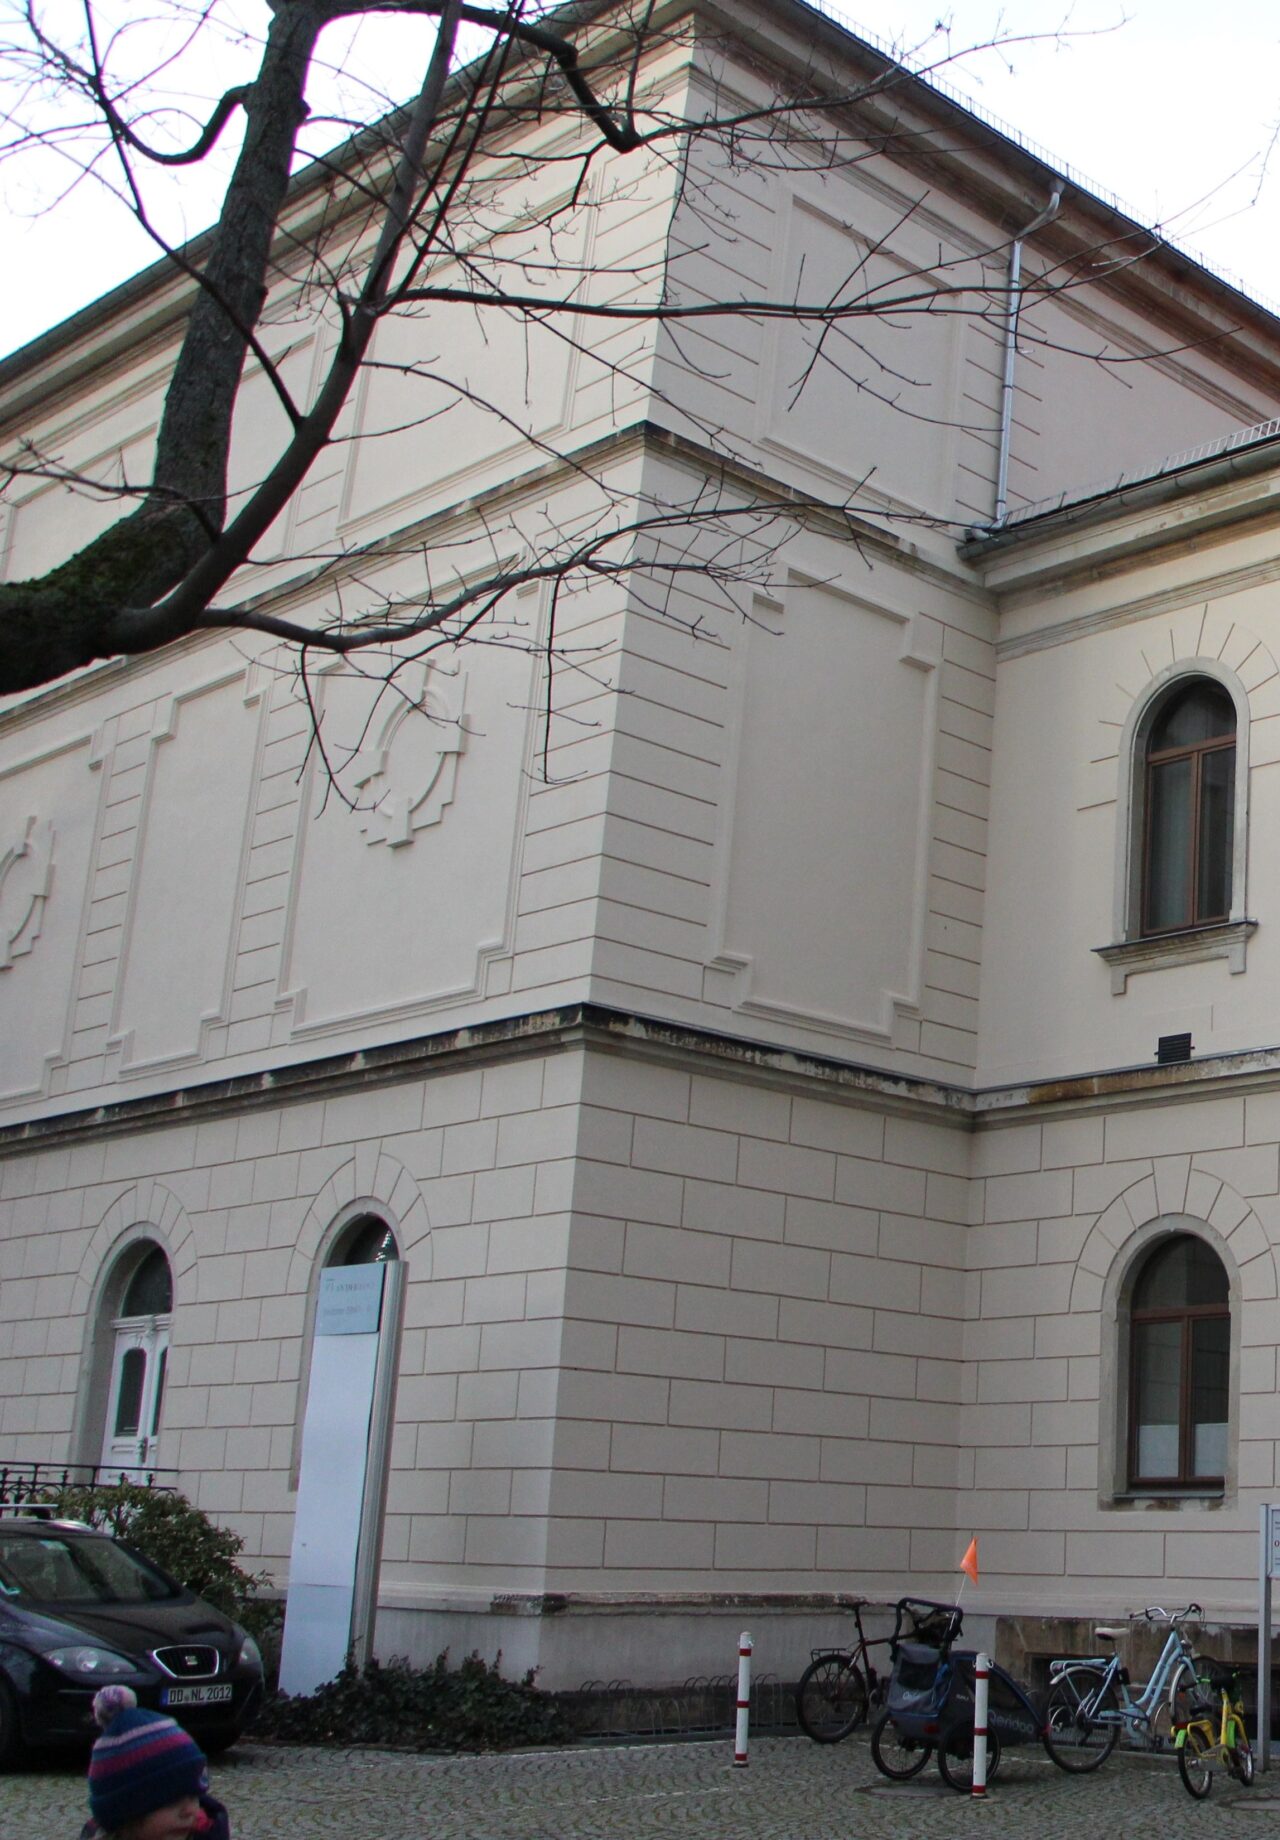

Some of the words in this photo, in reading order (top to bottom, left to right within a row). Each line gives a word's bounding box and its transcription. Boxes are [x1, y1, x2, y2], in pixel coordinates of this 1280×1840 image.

[170, 1689, 183, 1702] DD
[191, 1688, 204, 1701] NL
[207, 1687, 230, 1700] 2012
